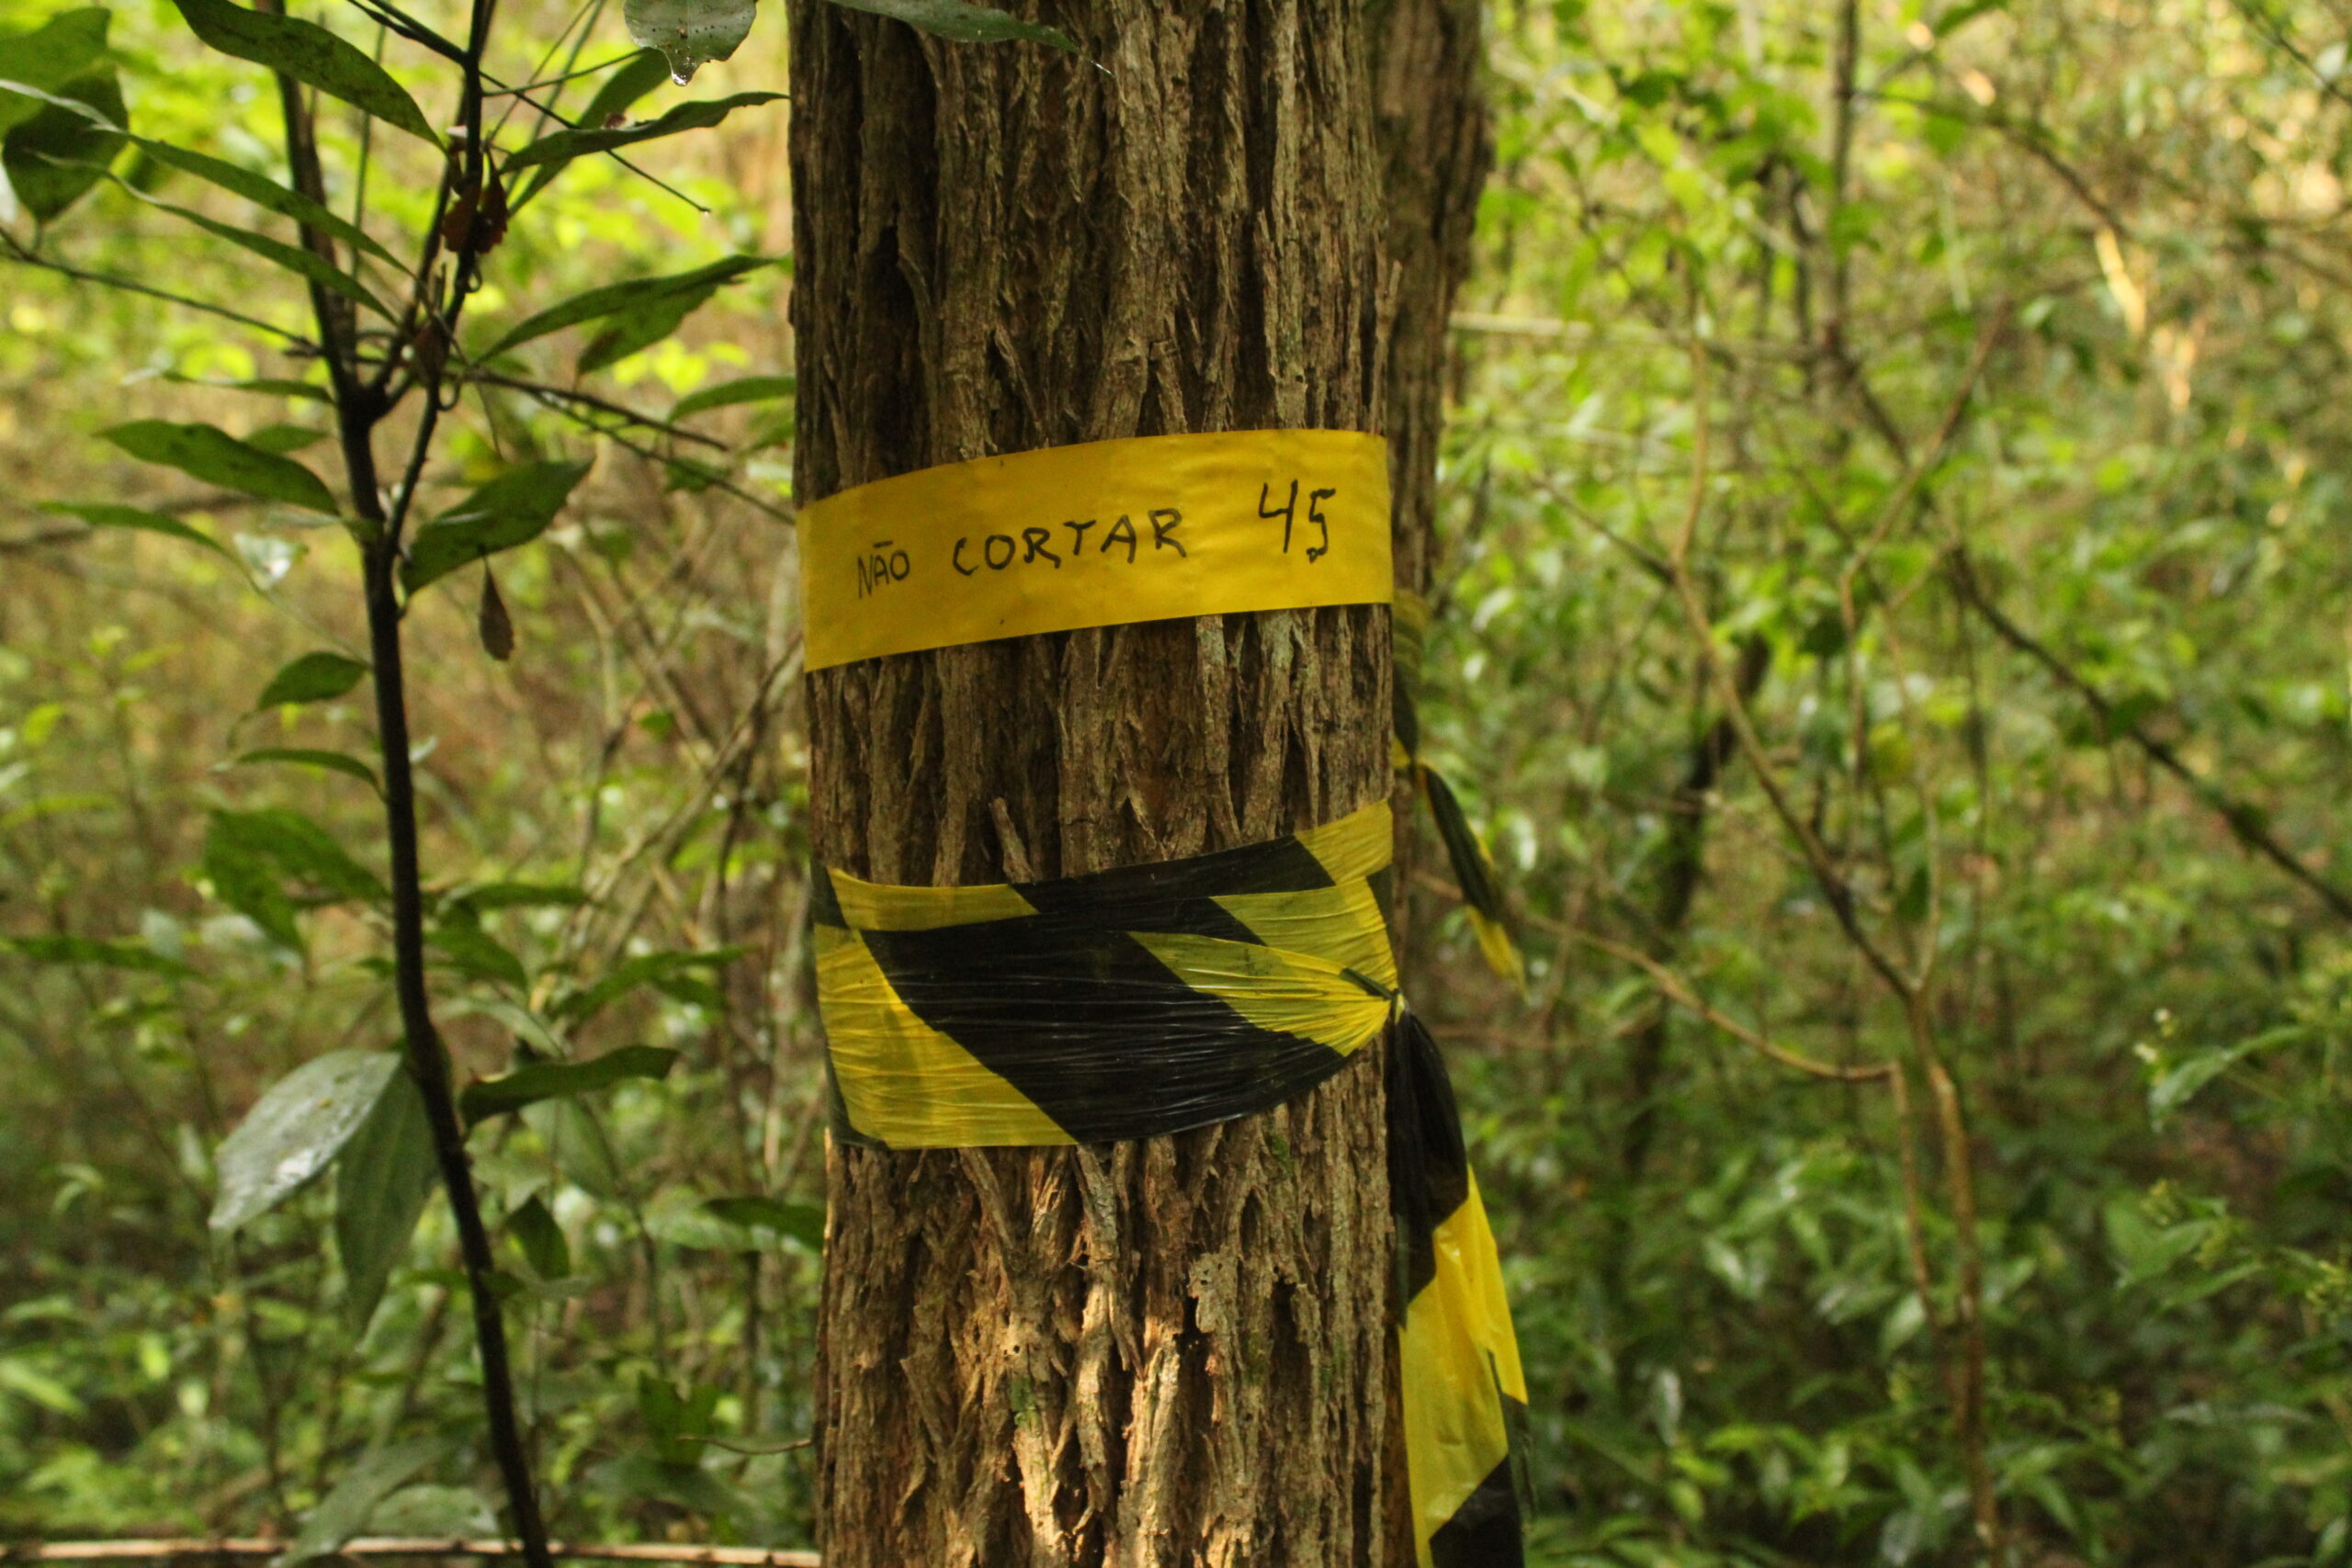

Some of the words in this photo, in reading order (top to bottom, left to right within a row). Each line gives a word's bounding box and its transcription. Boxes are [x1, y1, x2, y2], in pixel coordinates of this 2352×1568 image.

[855, 539, 911, 600] NÃO
[951, 507, 1187, 577] CORTAR
[1258, 479, 1336, 564] 45
